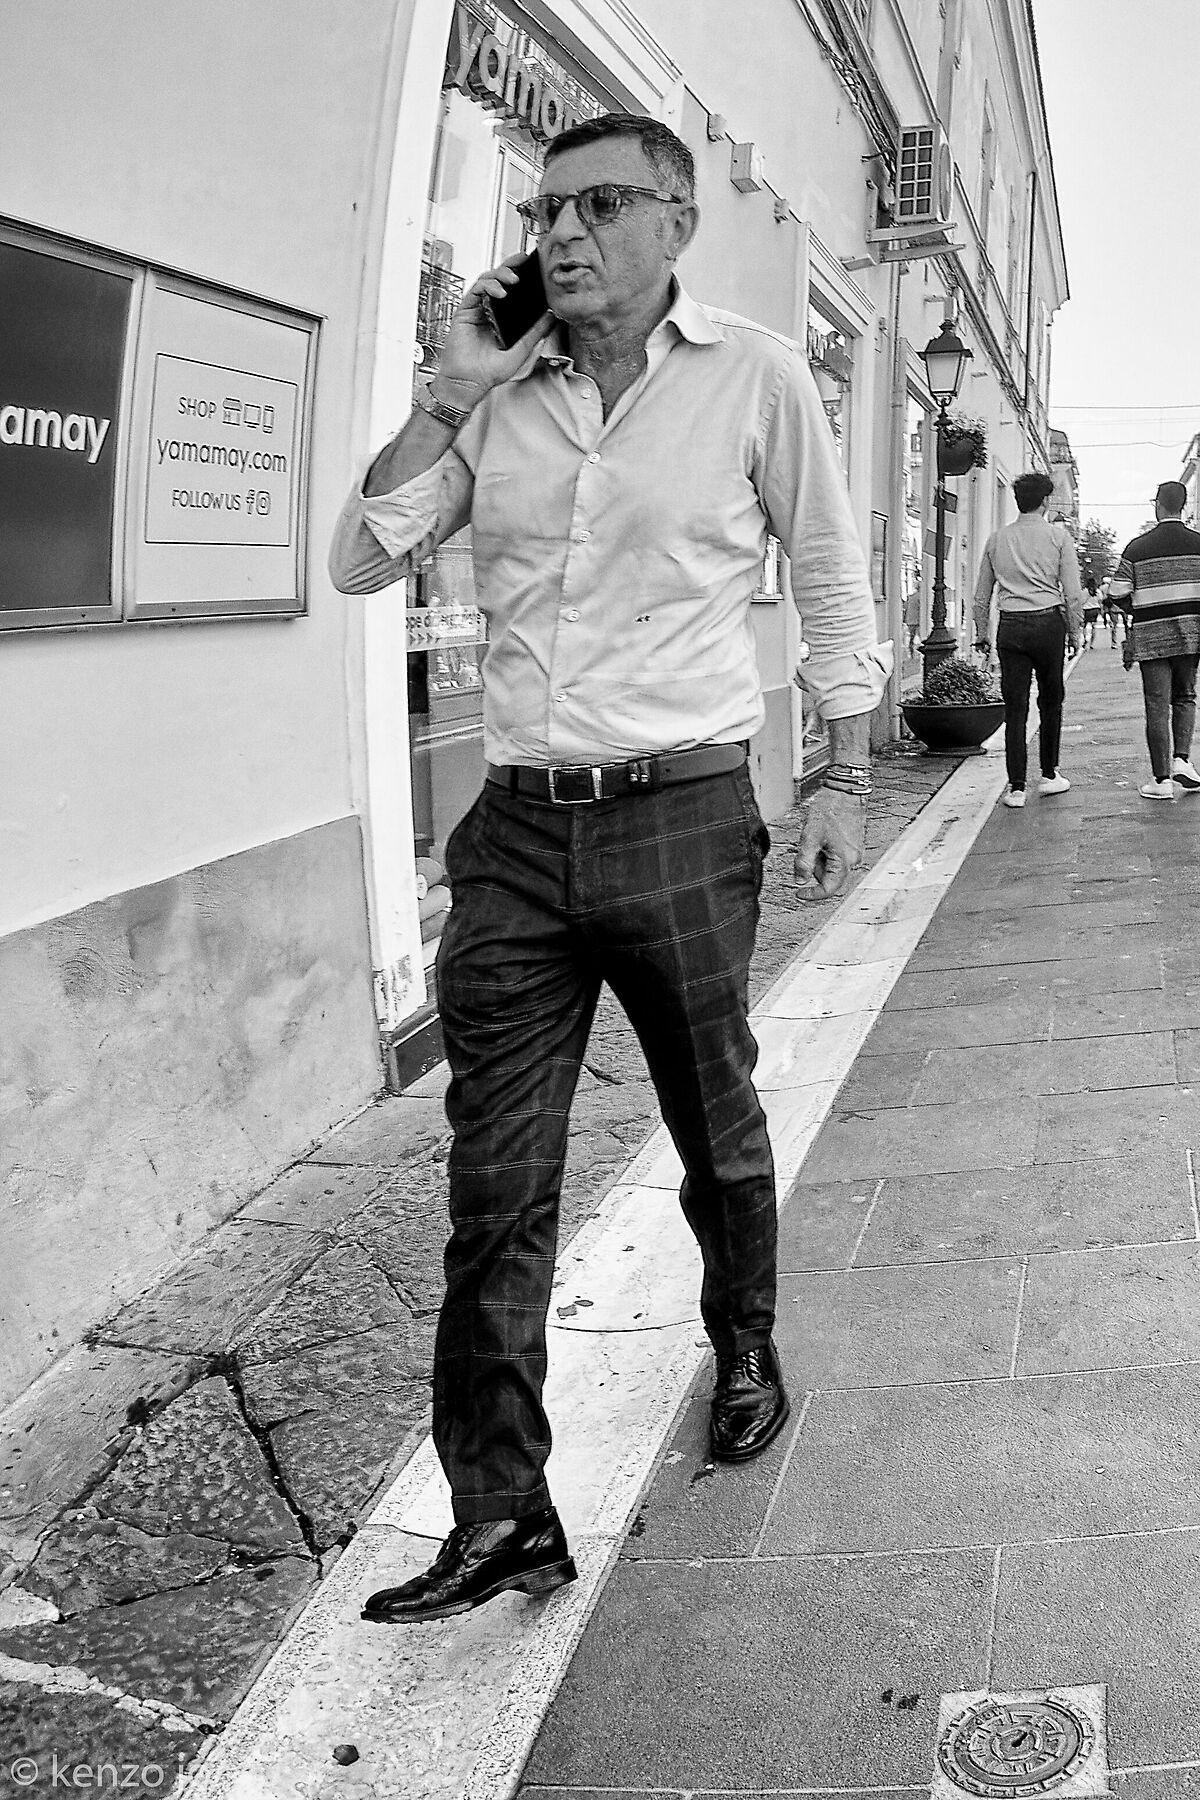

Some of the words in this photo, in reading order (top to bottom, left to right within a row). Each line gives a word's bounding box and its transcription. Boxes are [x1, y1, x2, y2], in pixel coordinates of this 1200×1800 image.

[178, 396, 216, 419] SHOP
[0, 404, 110, 463] amay
[157, 438, 287, 473] yamamay.com
[172, 489, 223, 510] FOLLOW
[226, 493, 241, 511] US
